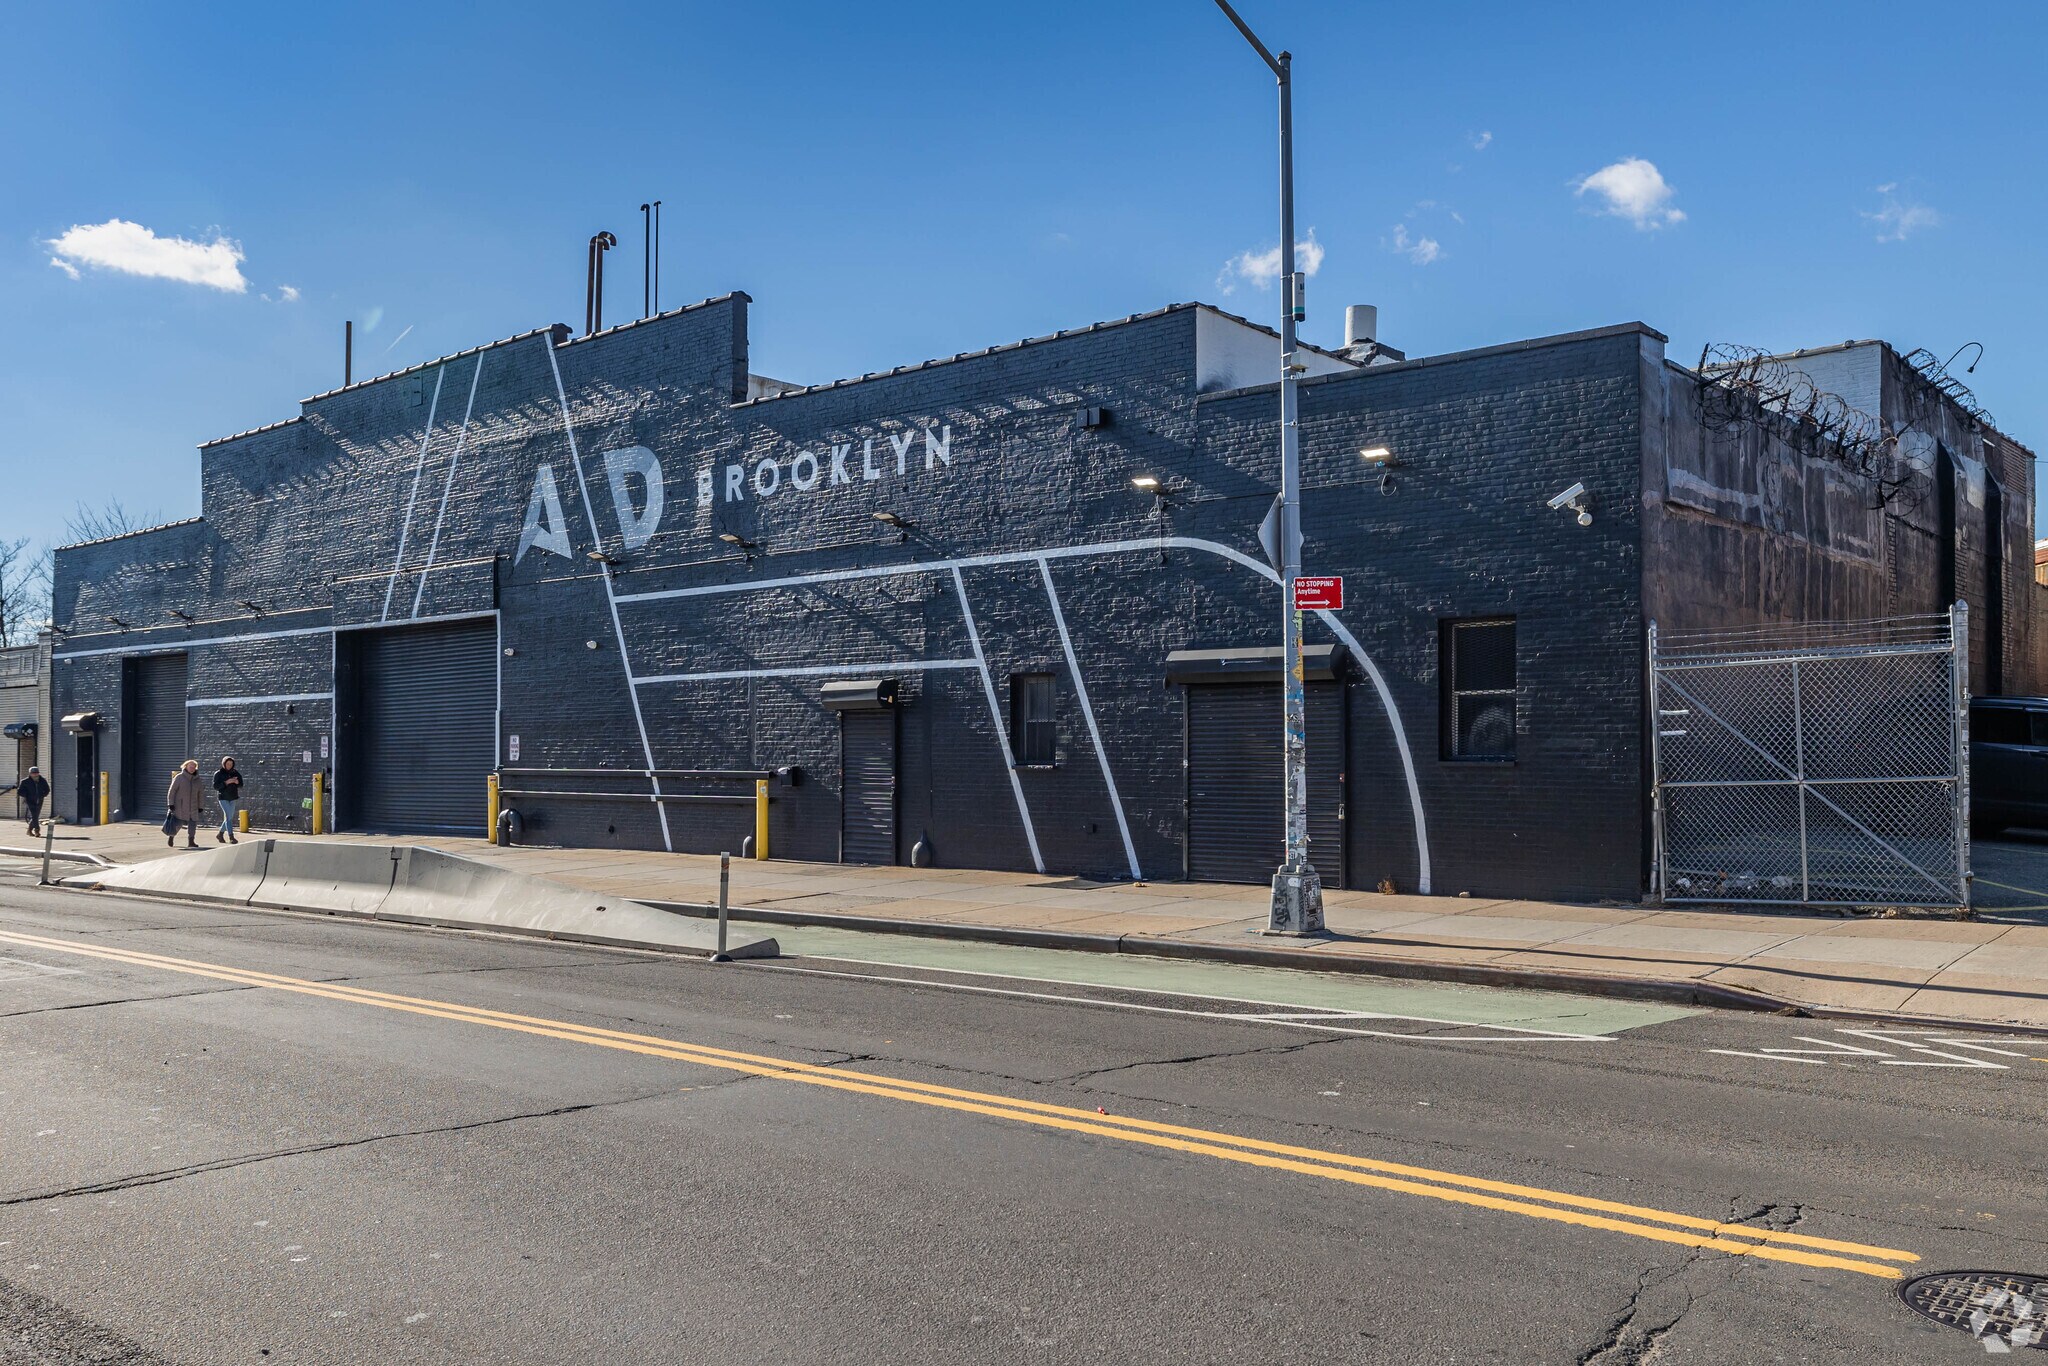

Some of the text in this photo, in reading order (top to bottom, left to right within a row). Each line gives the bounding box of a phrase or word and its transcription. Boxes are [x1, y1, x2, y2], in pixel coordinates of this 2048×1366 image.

[698, 424, 951, 507] BROOKLYN
[1296, 580, 1305, 588] NO
[1297, 588, 1320, 596] Anytime
